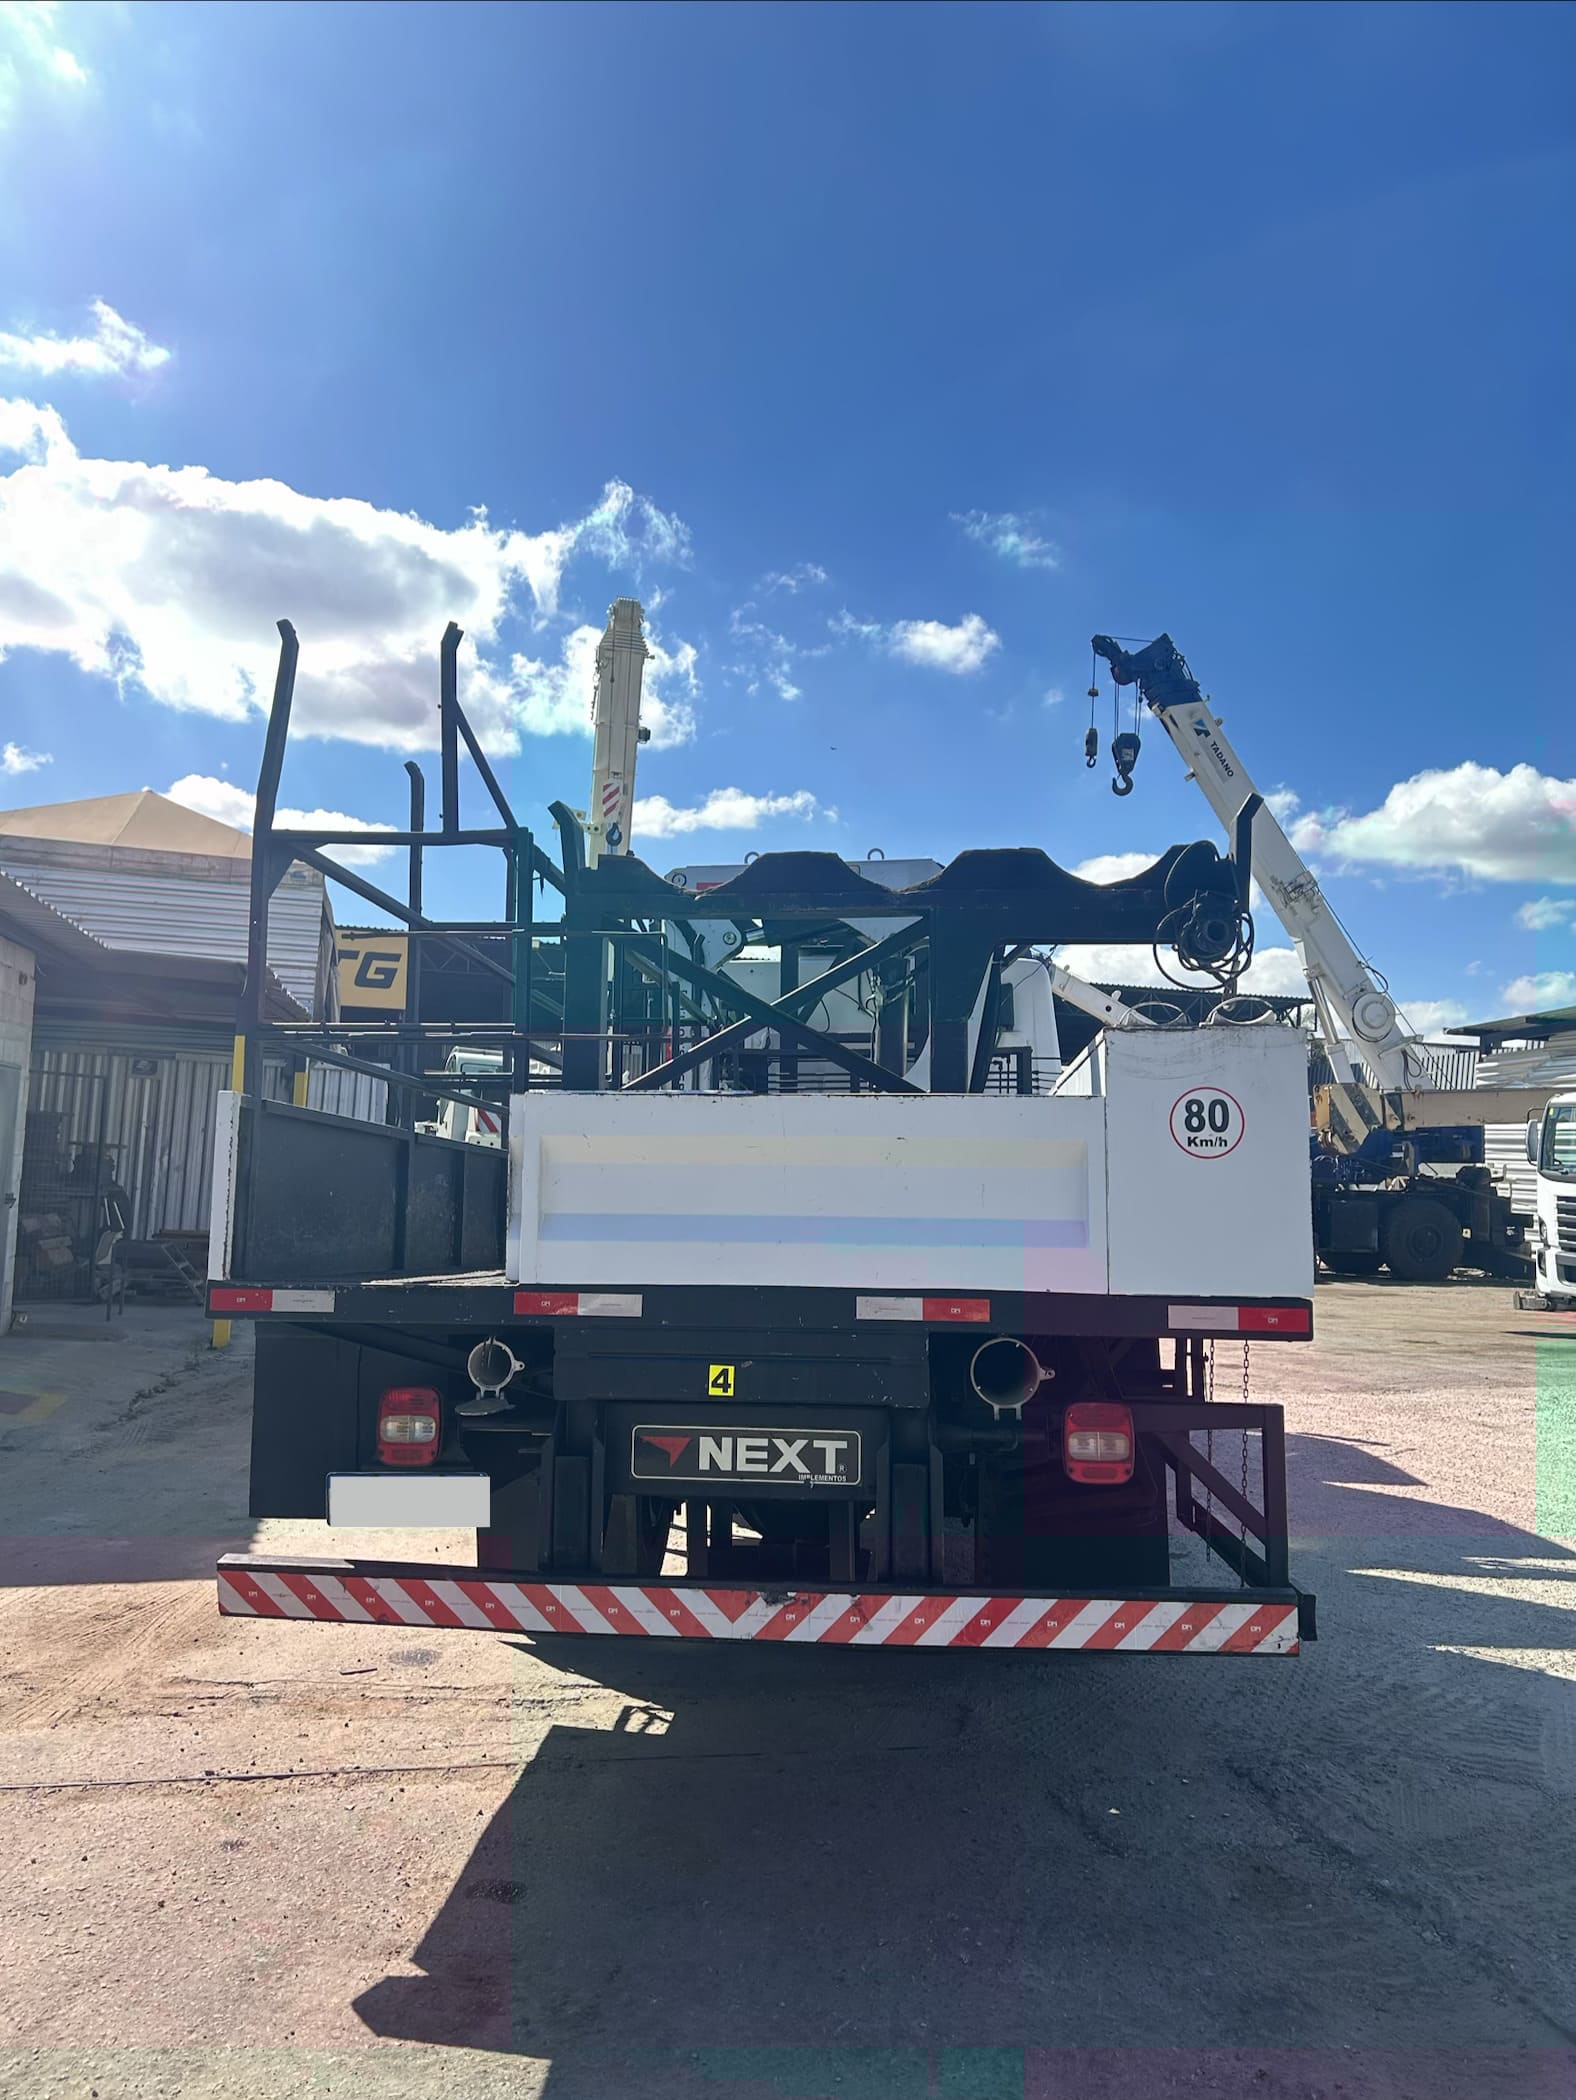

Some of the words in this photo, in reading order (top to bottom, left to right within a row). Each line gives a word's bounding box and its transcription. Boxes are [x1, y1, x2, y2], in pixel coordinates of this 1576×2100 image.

[1210, 741, 1234, 777] TADANO
[1185, 1099, 1230, 1133] 80
[1187, 1136, 1228, 1147] Km/h
[711, 1368, 732, 1393] 4
[698, 1436, 848, 1475] NEXT
